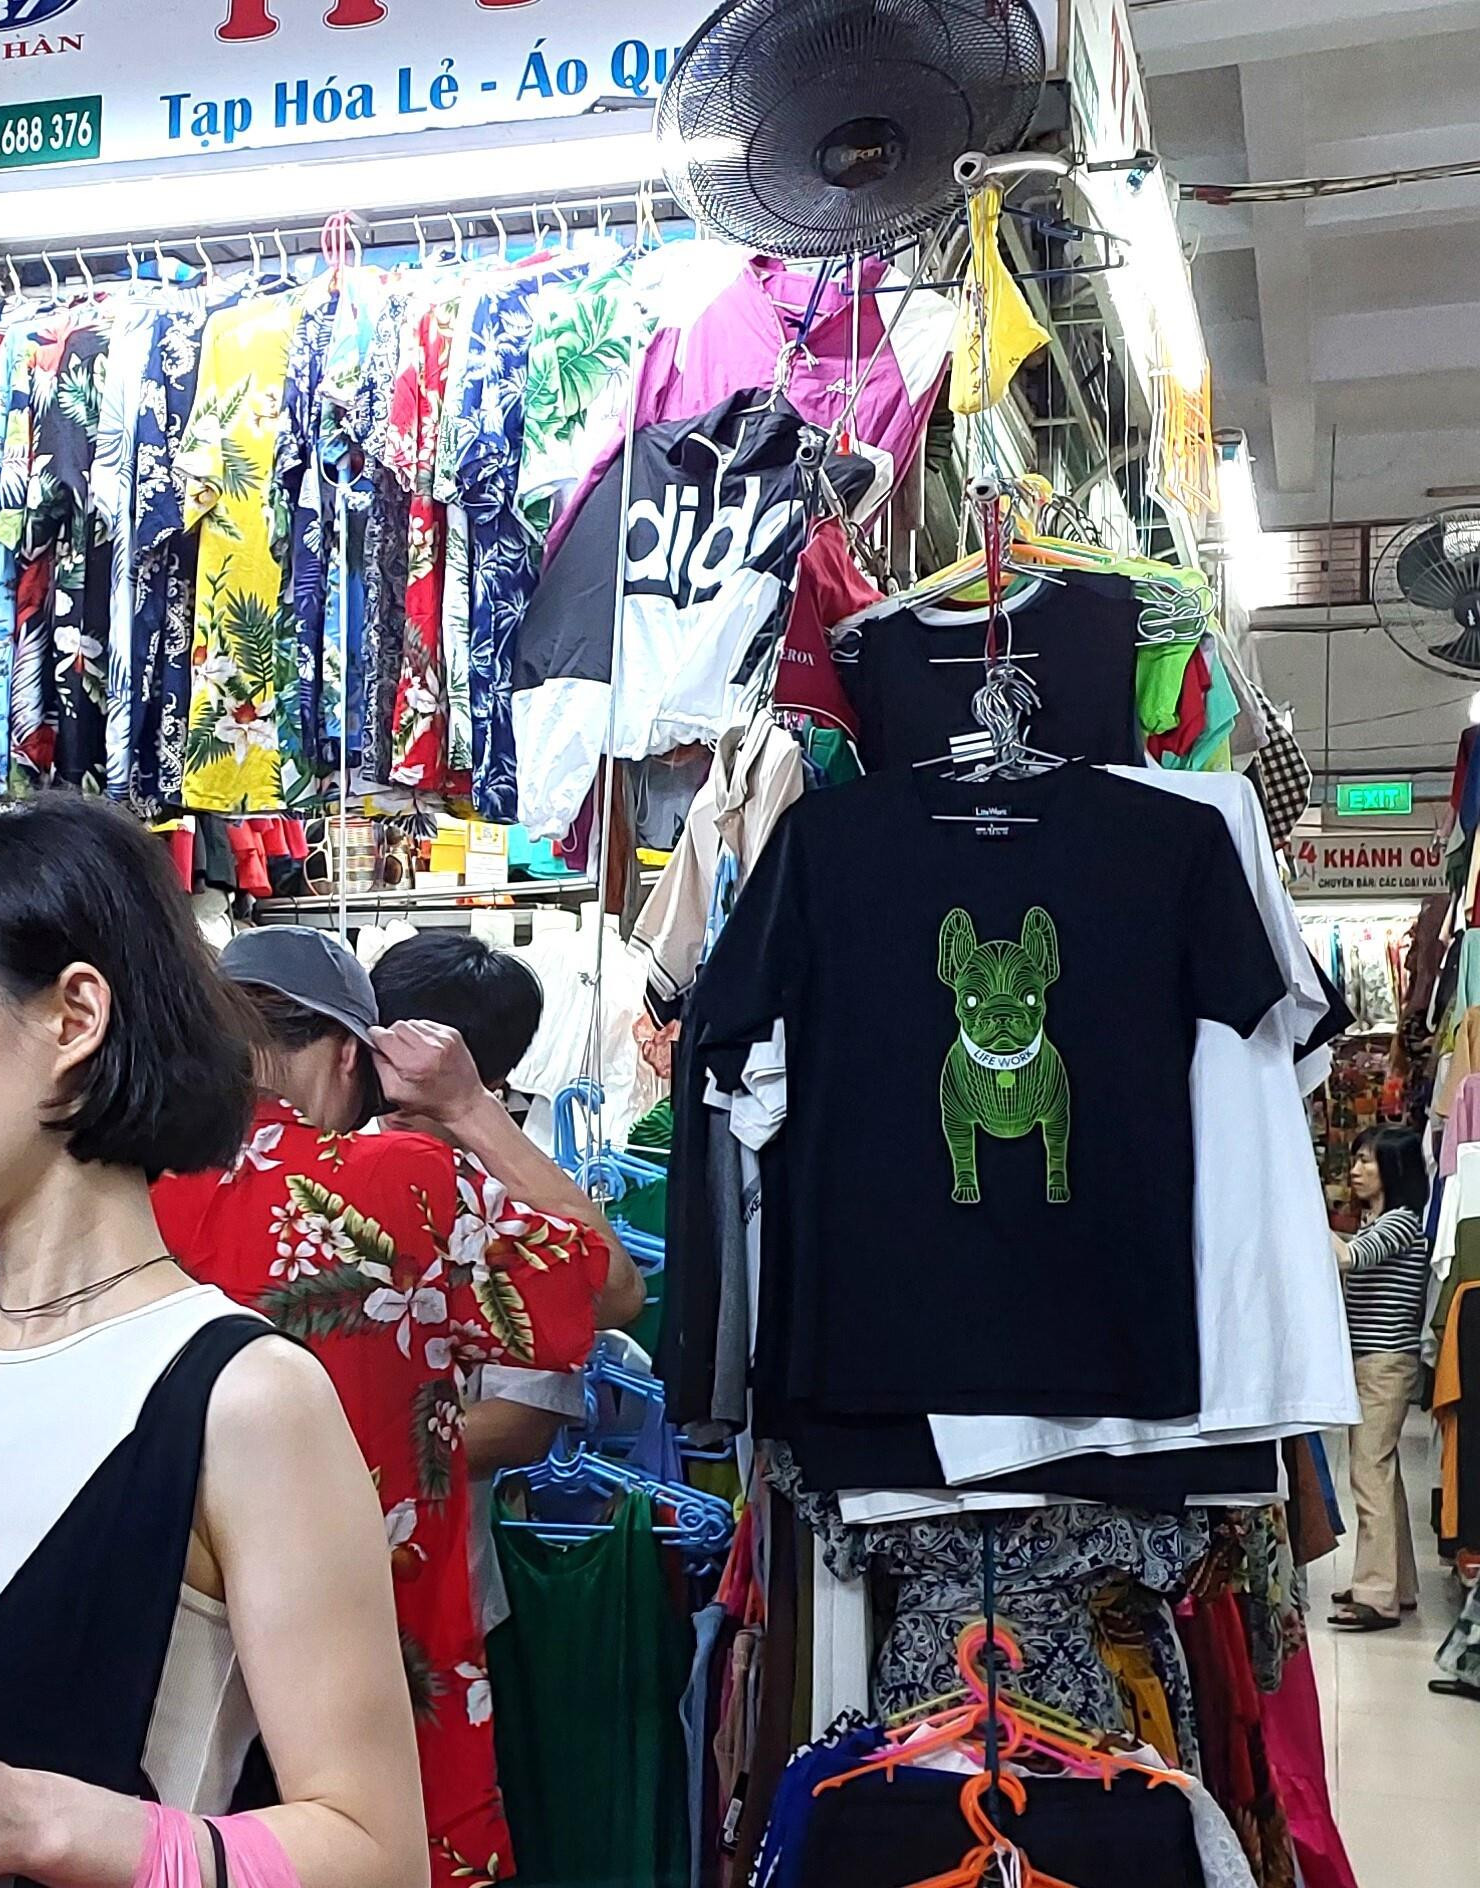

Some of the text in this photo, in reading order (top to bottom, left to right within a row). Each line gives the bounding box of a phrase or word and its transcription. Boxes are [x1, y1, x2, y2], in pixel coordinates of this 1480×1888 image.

[2, 33, 85, 61] HÀN
[160, 93, 252, 147] Tạp
[275, 75, 376, 128] Hóa
[398, 58, 459, 114] Lẻ
[516, 38, 588, 101] Áo
[50, 111, 93, 150] 376
[1349, 789, 1399, 808] EXIT
[1324, 843, 1402, 868] KHÁNH
[973, 1049, 1034, 1067] LIFE WORK
